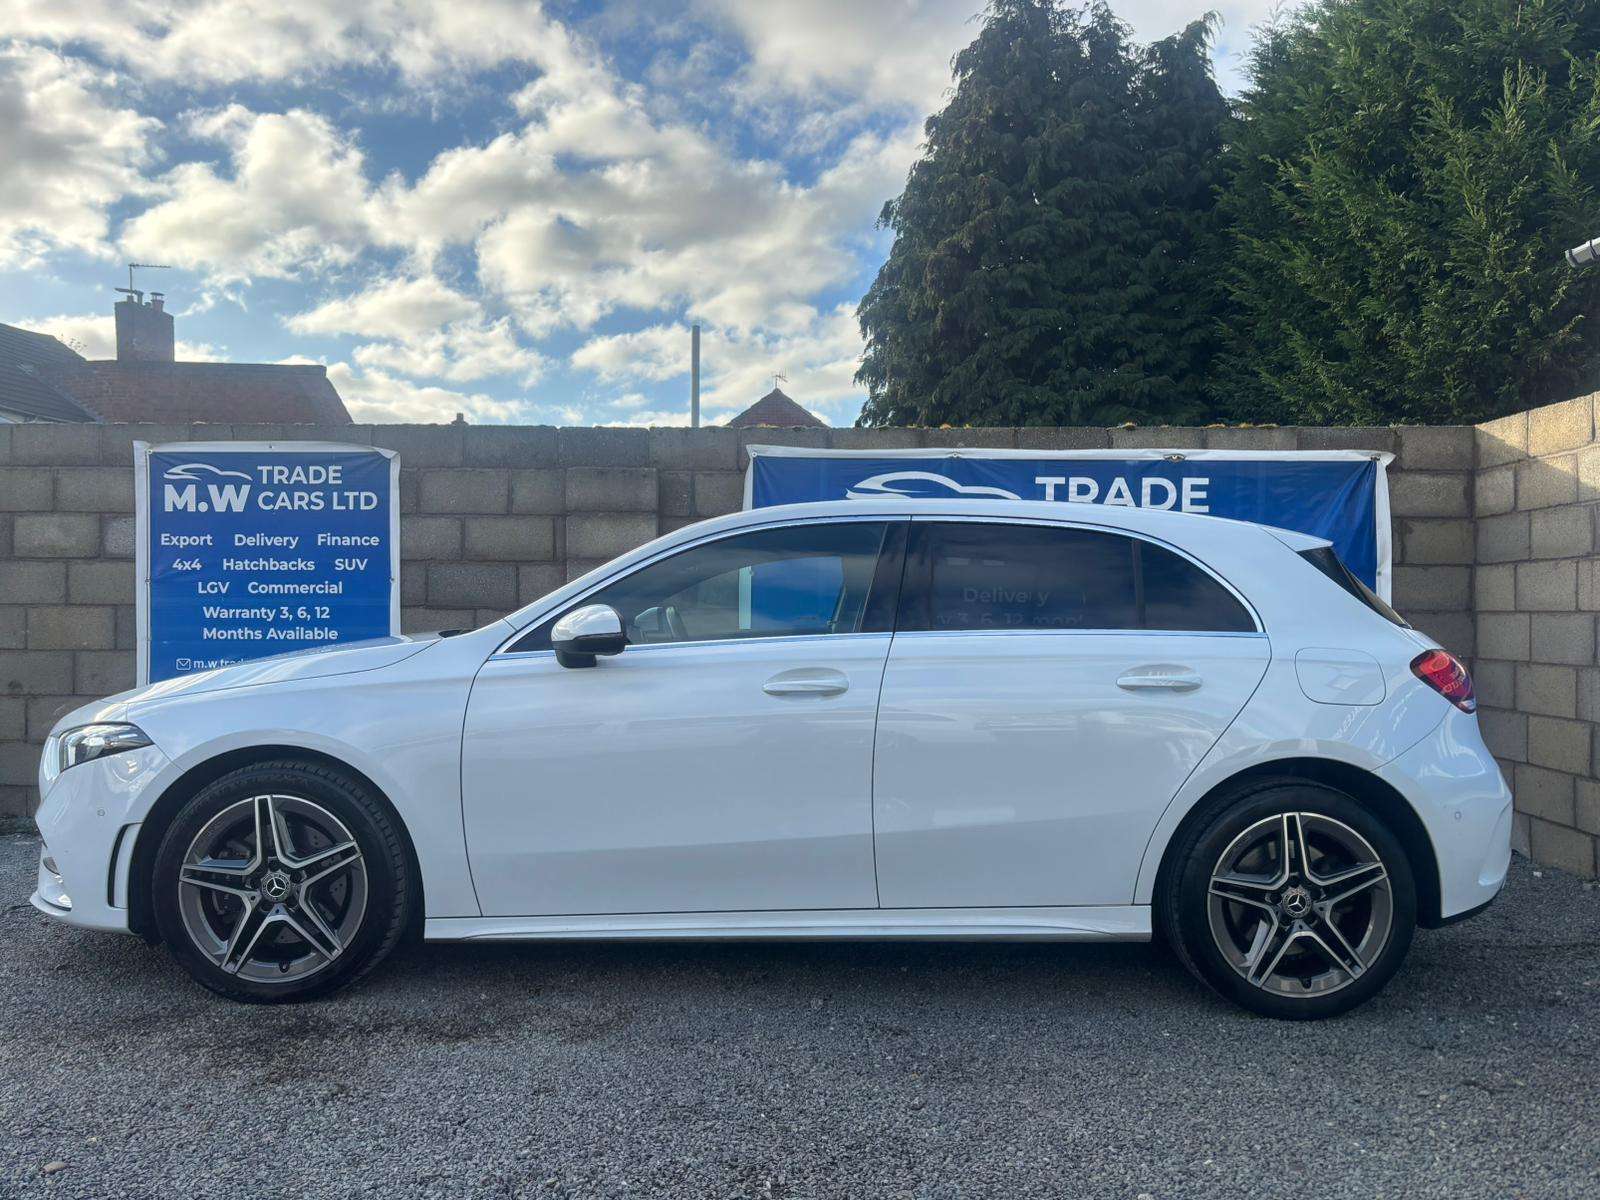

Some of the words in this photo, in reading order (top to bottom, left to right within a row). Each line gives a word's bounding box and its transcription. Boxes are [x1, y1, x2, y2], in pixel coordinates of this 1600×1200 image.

[257, 465, 343, 485] TRADE
[163, 484, 251, 513] M.W
[257, 491, 326, 511] CARS
[332, 491, 378, 510] LTD
[1035, 476, 1210, 513] TRADE
[160, 533, 213, 549] Export
[234, 533, 299, 549] Delivery
[317, 532, 380, 546] Finance
[172, 558, 202, 571] 4x4
[223, 558, 316, 571] Hatchbacks
[334, 558, 368, 571] SUV
[197, 581, 231, 594] LGV
[247, 581, 343, 594] Commercial
[203, 606, 276, 621] Warranty
[279, 606, 294, 621] 3,
[297, 606, 312, 621] 6,
[314, 606, 331, 619] 12
[203, 627, 263, 640] Months
[266, 627, 339, 640] Available
